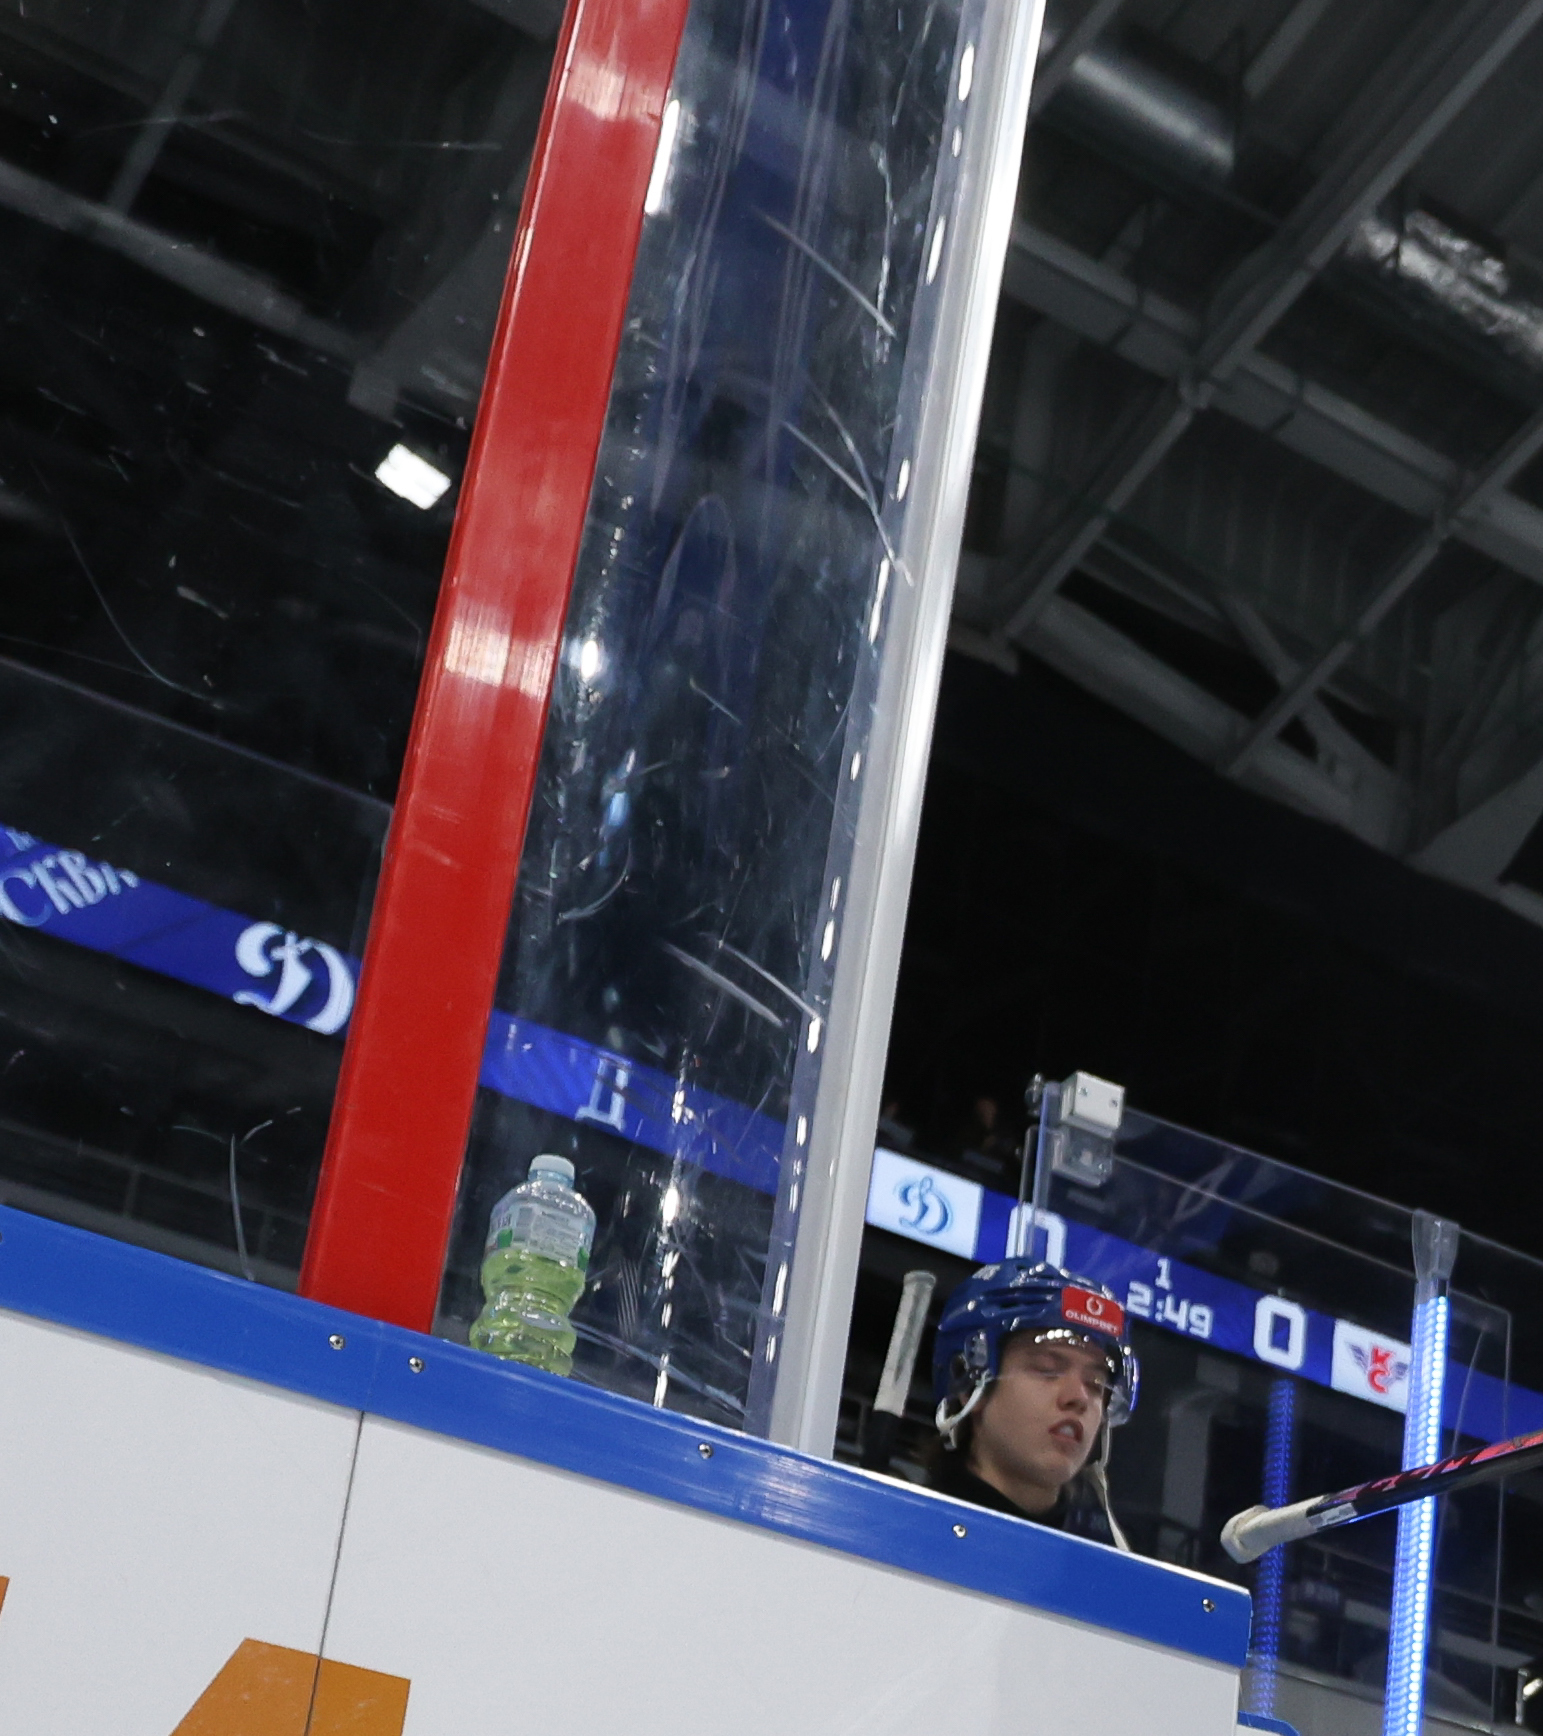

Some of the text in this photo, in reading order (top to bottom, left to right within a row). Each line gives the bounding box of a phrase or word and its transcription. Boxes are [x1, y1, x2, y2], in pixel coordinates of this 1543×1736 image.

[1154, 1257, 1176, 1291] 1
[1126, 1280, 1215, 1340] 2:49
[1253, 1297, 1305, 1371] 0
